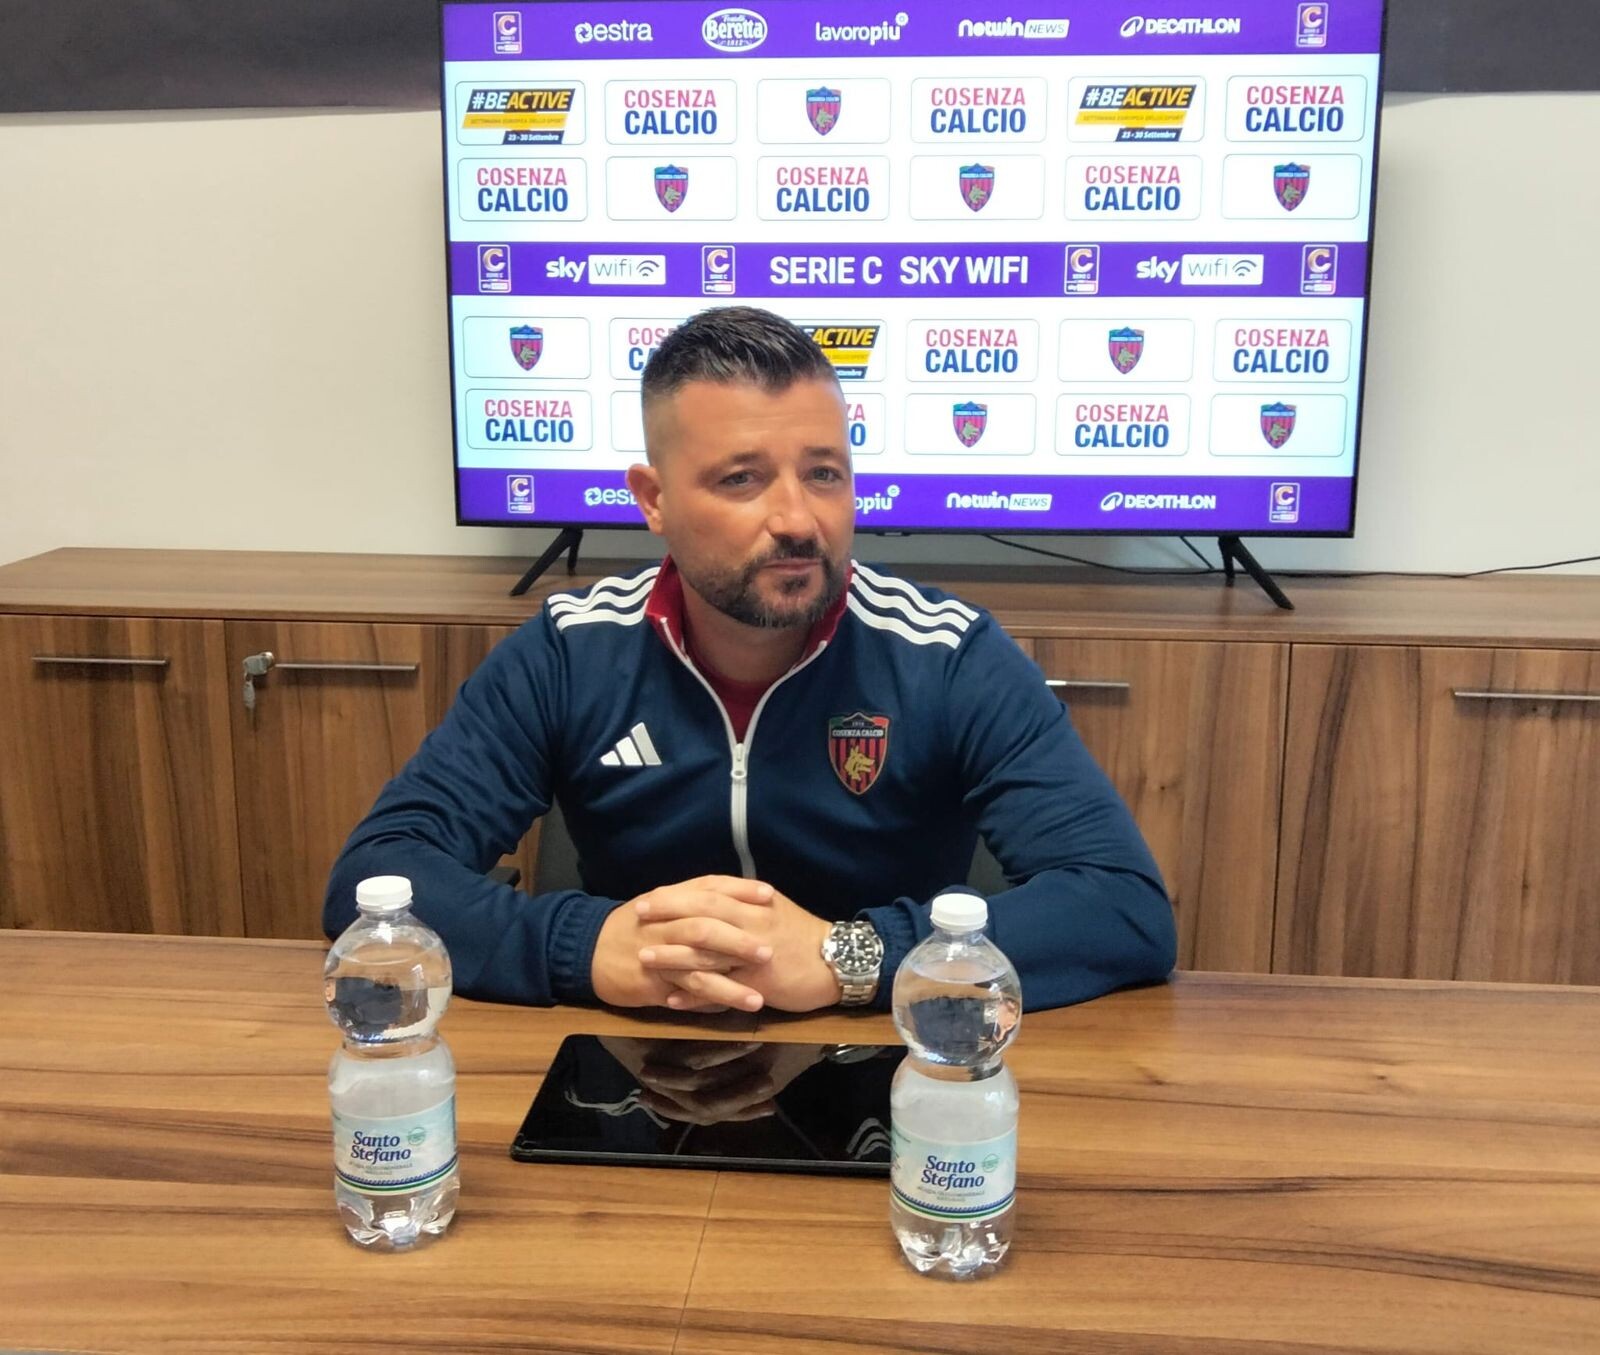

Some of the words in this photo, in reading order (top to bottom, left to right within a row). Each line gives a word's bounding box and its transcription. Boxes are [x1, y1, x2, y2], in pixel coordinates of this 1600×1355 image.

[593, 19, 653, 42] estra
[706, 19, 763, 40] Beretta
[1028, 23, 1066, 34] NEWS
[1145, 18, 1241, 34] DECATHLON
[472, 91, 571, 110] #BEACTIVE
[624, 89, 717, 108] COSENZA
[931, 87, 1026, 106] COSENZA
[1086, 87, 1192, 107] #BEACTIVE
[1246, 85, 1344, 105] COSENZA
[624, 110, 717, 135] CALCIO
[930, 108, 1026, 133] CALCIO
[1245, 107, 1344, 132] CALCIO
[476, 168, 567, 186] COSENZA
[776, 167, 870, 185] COSENZA
[1085, 165, 1181, 184] COSENZA
[478, 188, 568, 212] CALCIO
[776, 187, 870, 212] CALCIO
[1084, 186, 1181, 211] CALCIO
[483, 248, 506, 272] C
[545, 256, 587, 283] sky
[594, 258, 633, 277] wifi
[707, 249, 730, 274] C
[770, 256, 855, 284] SERIE
[862, 256, 883, 284] C
[900, 256, 960, 284] SKY
[965, 256, 1028, 284] WIFI
[1071, 248, 1094, 273] C
[1136, 256, 1180, 284] sky
[1188, 258, 1228, 277] wifi
[1307, 248, 1331, 273] C
[803, 328, 876, 346] ACTIVE
[926, 328, 1018, 347] COSENZA
[1235, 328, 1329, 347] COSENZA
[925, 349, 1018, 373] CALCIO
[1233, 349, 1329, 373] CALCIO
[485, 399, 572, 418] COSENZA
[1075, 404, 1169, 422] COSENZA
[485, 419, 574, 443] CALCIO
[1074, 424, 1169, 448] CALCIO
[1013, 497, 1048, 507] NEWS
[1124, 494, 1216, 509] DECATHLON
[353, 1131, 400, 1147] Santo
[350, 1145, 411, 1165] Stefano
[926, 1155, 976, 1173] Santo
[921, 1169, 985, 1191] Stefano
